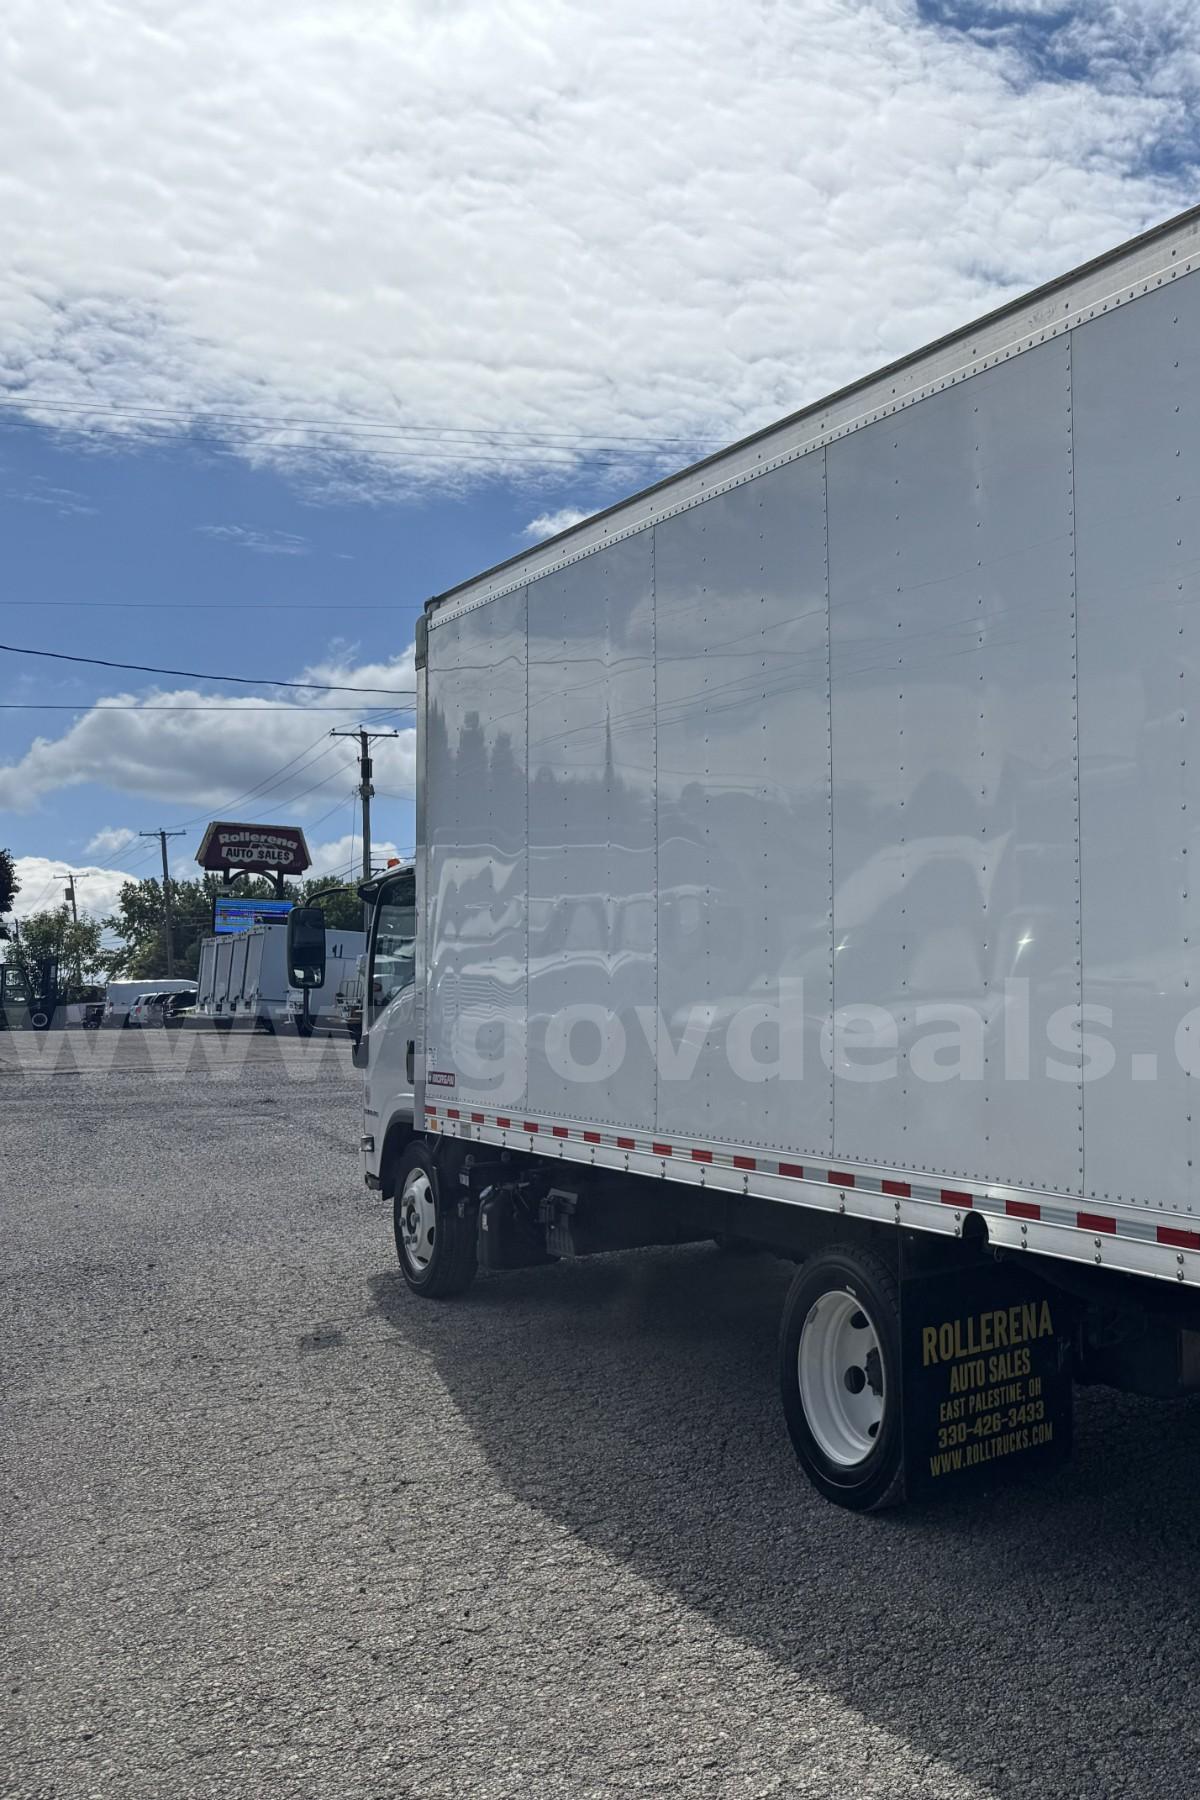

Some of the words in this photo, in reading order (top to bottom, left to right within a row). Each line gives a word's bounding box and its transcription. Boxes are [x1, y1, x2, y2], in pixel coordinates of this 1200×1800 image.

[218, 832, 298, 850] Rollerena
[225, 847, 254, 858] AUTO
[257, 849, 291, 861] SALES
[432, 1073, 455, 1086] MORGAN
[922, 1300, 1053, 1367] ROLLERENA
[949, 1358, 986, 1394] AUTO
[988, 1347, 1031, 1384] SALES
[939, 1397, 966, 1423] EAST
[969, 1381, 1026, 1417] PALESTINE,
[1028, 1376, 1042, 1398] OH
[937, 1400, 1045, 1449] 330-426-3433
[929, 1421, 1054, 1477] WWW.ROLLTRUCKS.COM
